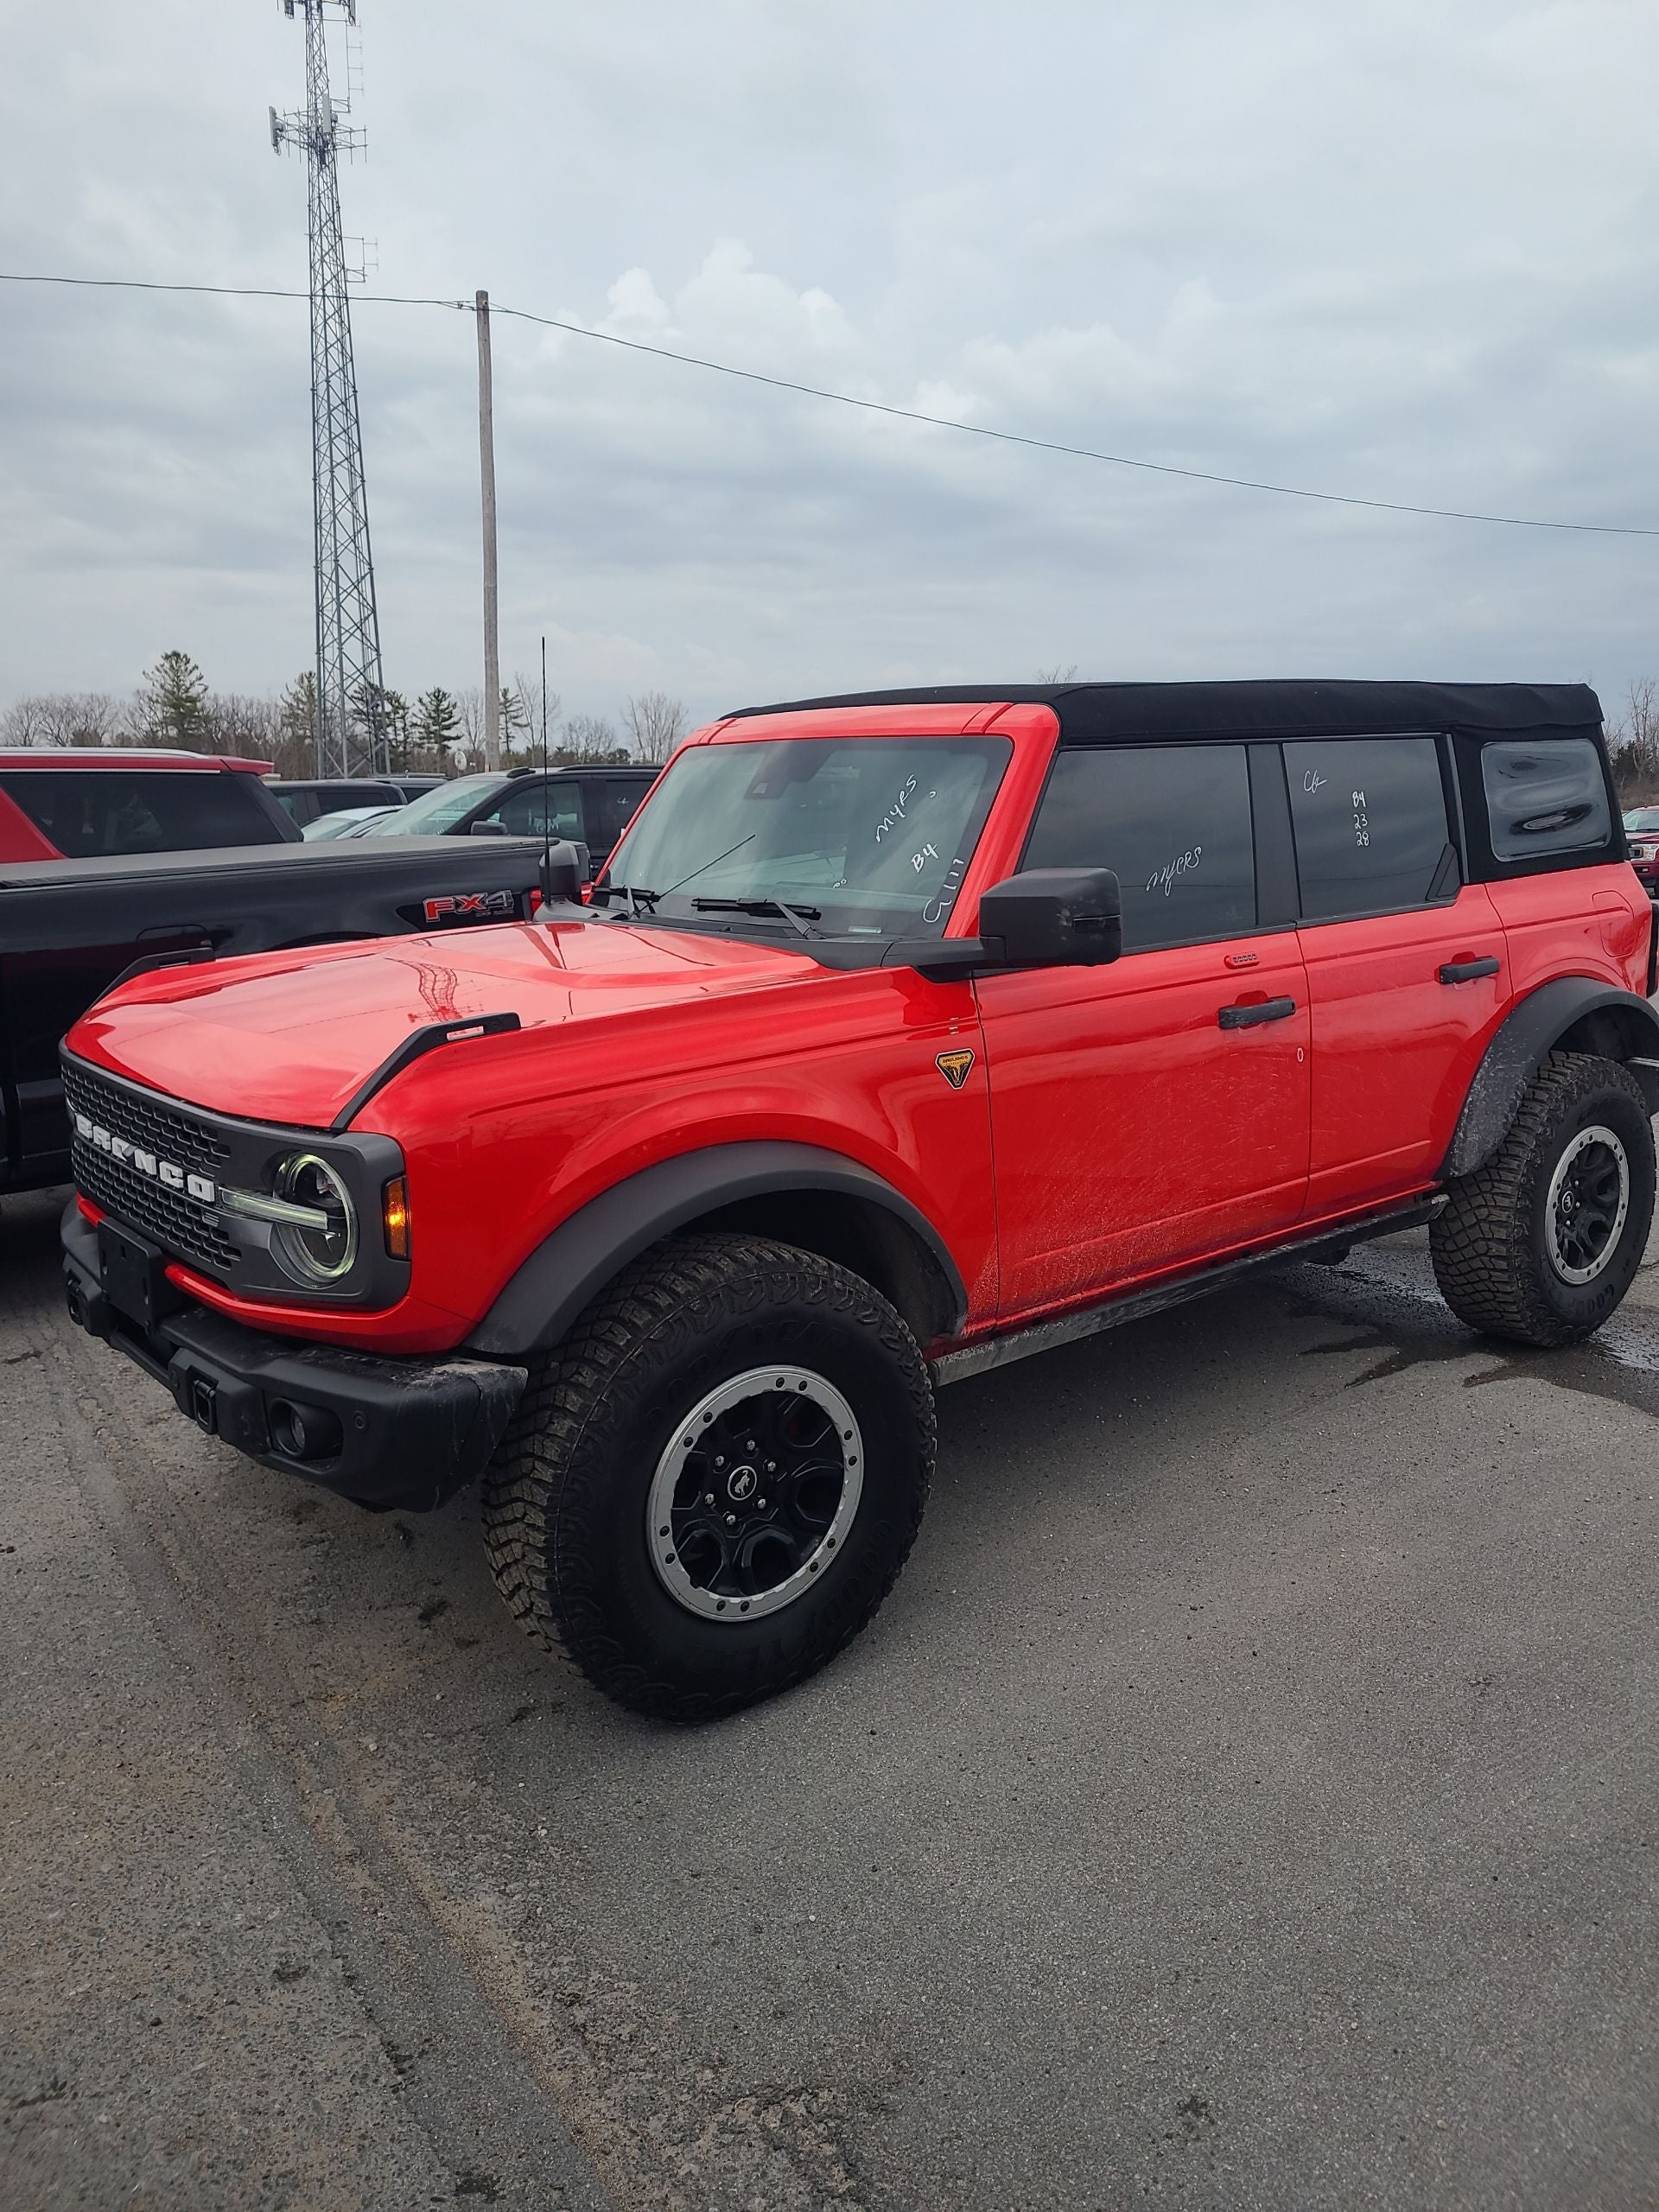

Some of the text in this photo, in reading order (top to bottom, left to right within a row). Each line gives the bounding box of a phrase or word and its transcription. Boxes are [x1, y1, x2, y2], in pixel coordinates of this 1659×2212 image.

[1353, 813, 1368, 830] 23
[1356, 830, 1370, 847] 28
[911, 842, 940, 874] B4
[423, 889, 515, 923] FX4
